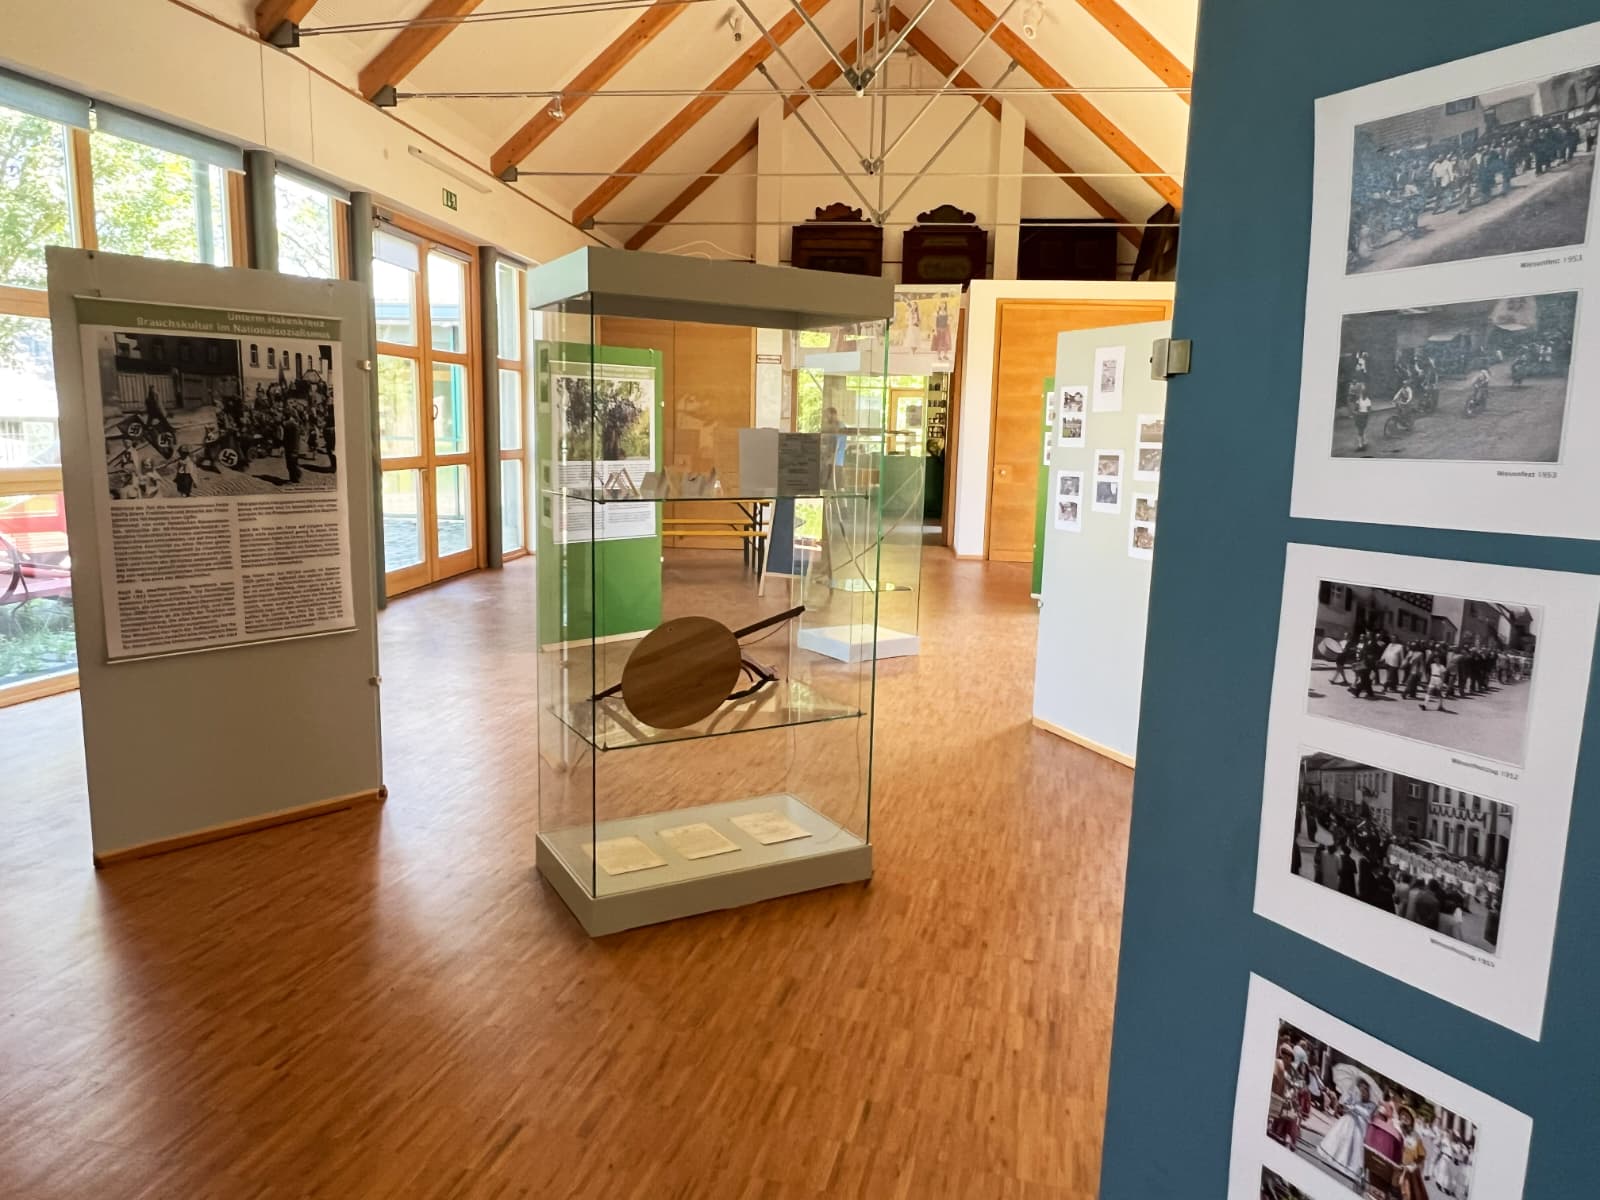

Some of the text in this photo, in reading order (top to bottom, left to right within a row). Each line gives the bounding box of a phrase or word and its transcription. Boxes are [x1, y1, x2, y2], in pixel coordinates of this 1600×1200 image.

[136, 316, 331, 339] Brauchskultur im Nationalsozialismus
[227, 312, 326, 328] Unterm Hakenkreuz
